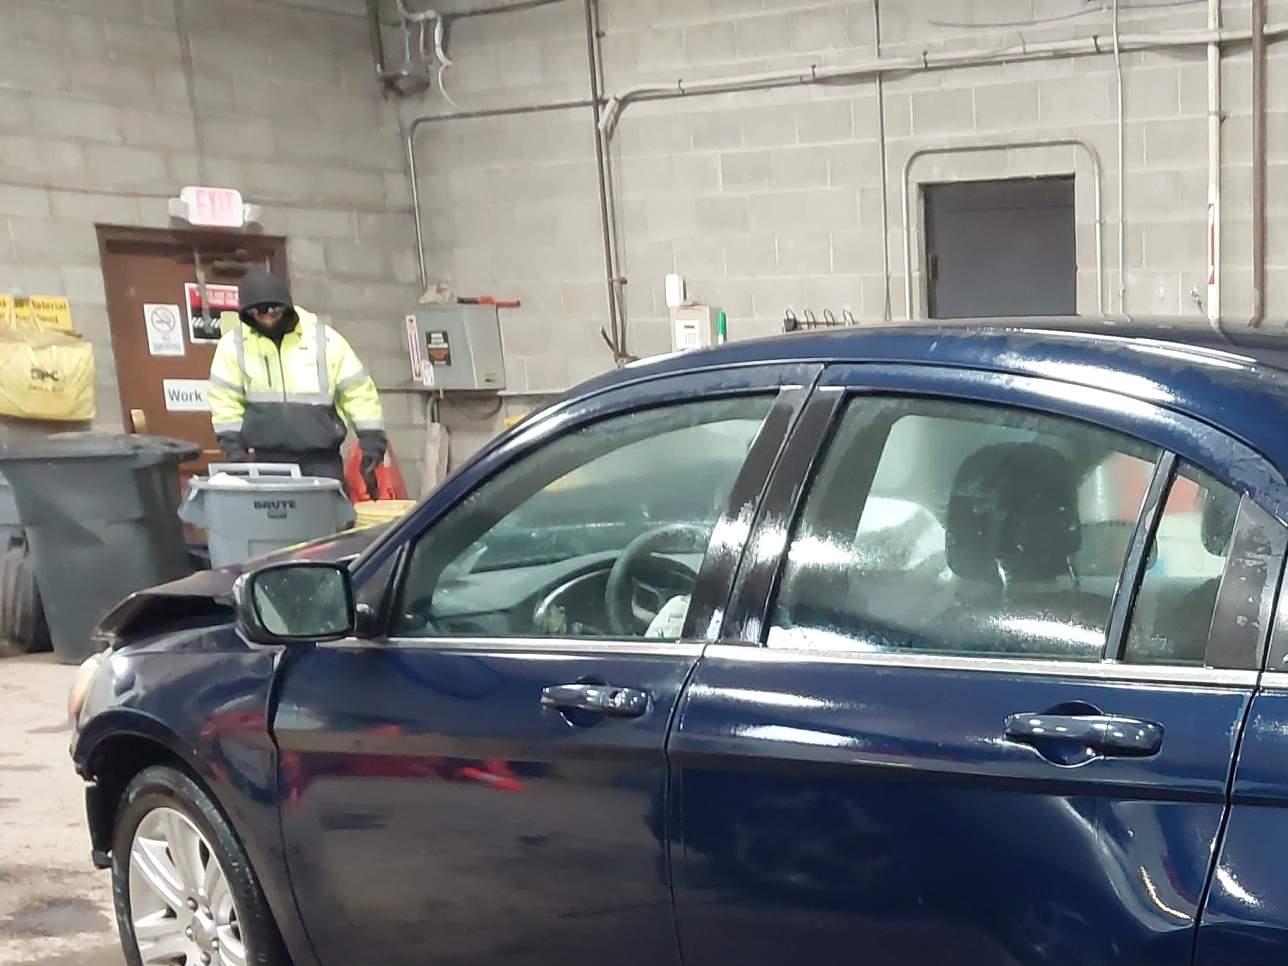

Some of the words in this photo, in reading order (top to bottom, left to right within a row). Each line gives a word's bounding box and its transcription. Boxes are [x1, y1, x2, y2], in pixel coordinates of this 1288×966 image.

[195, 190, 236, 217] EXIT
[168, 389, 203, 402] Work
[253, 500, 297, 510] BRUTE
